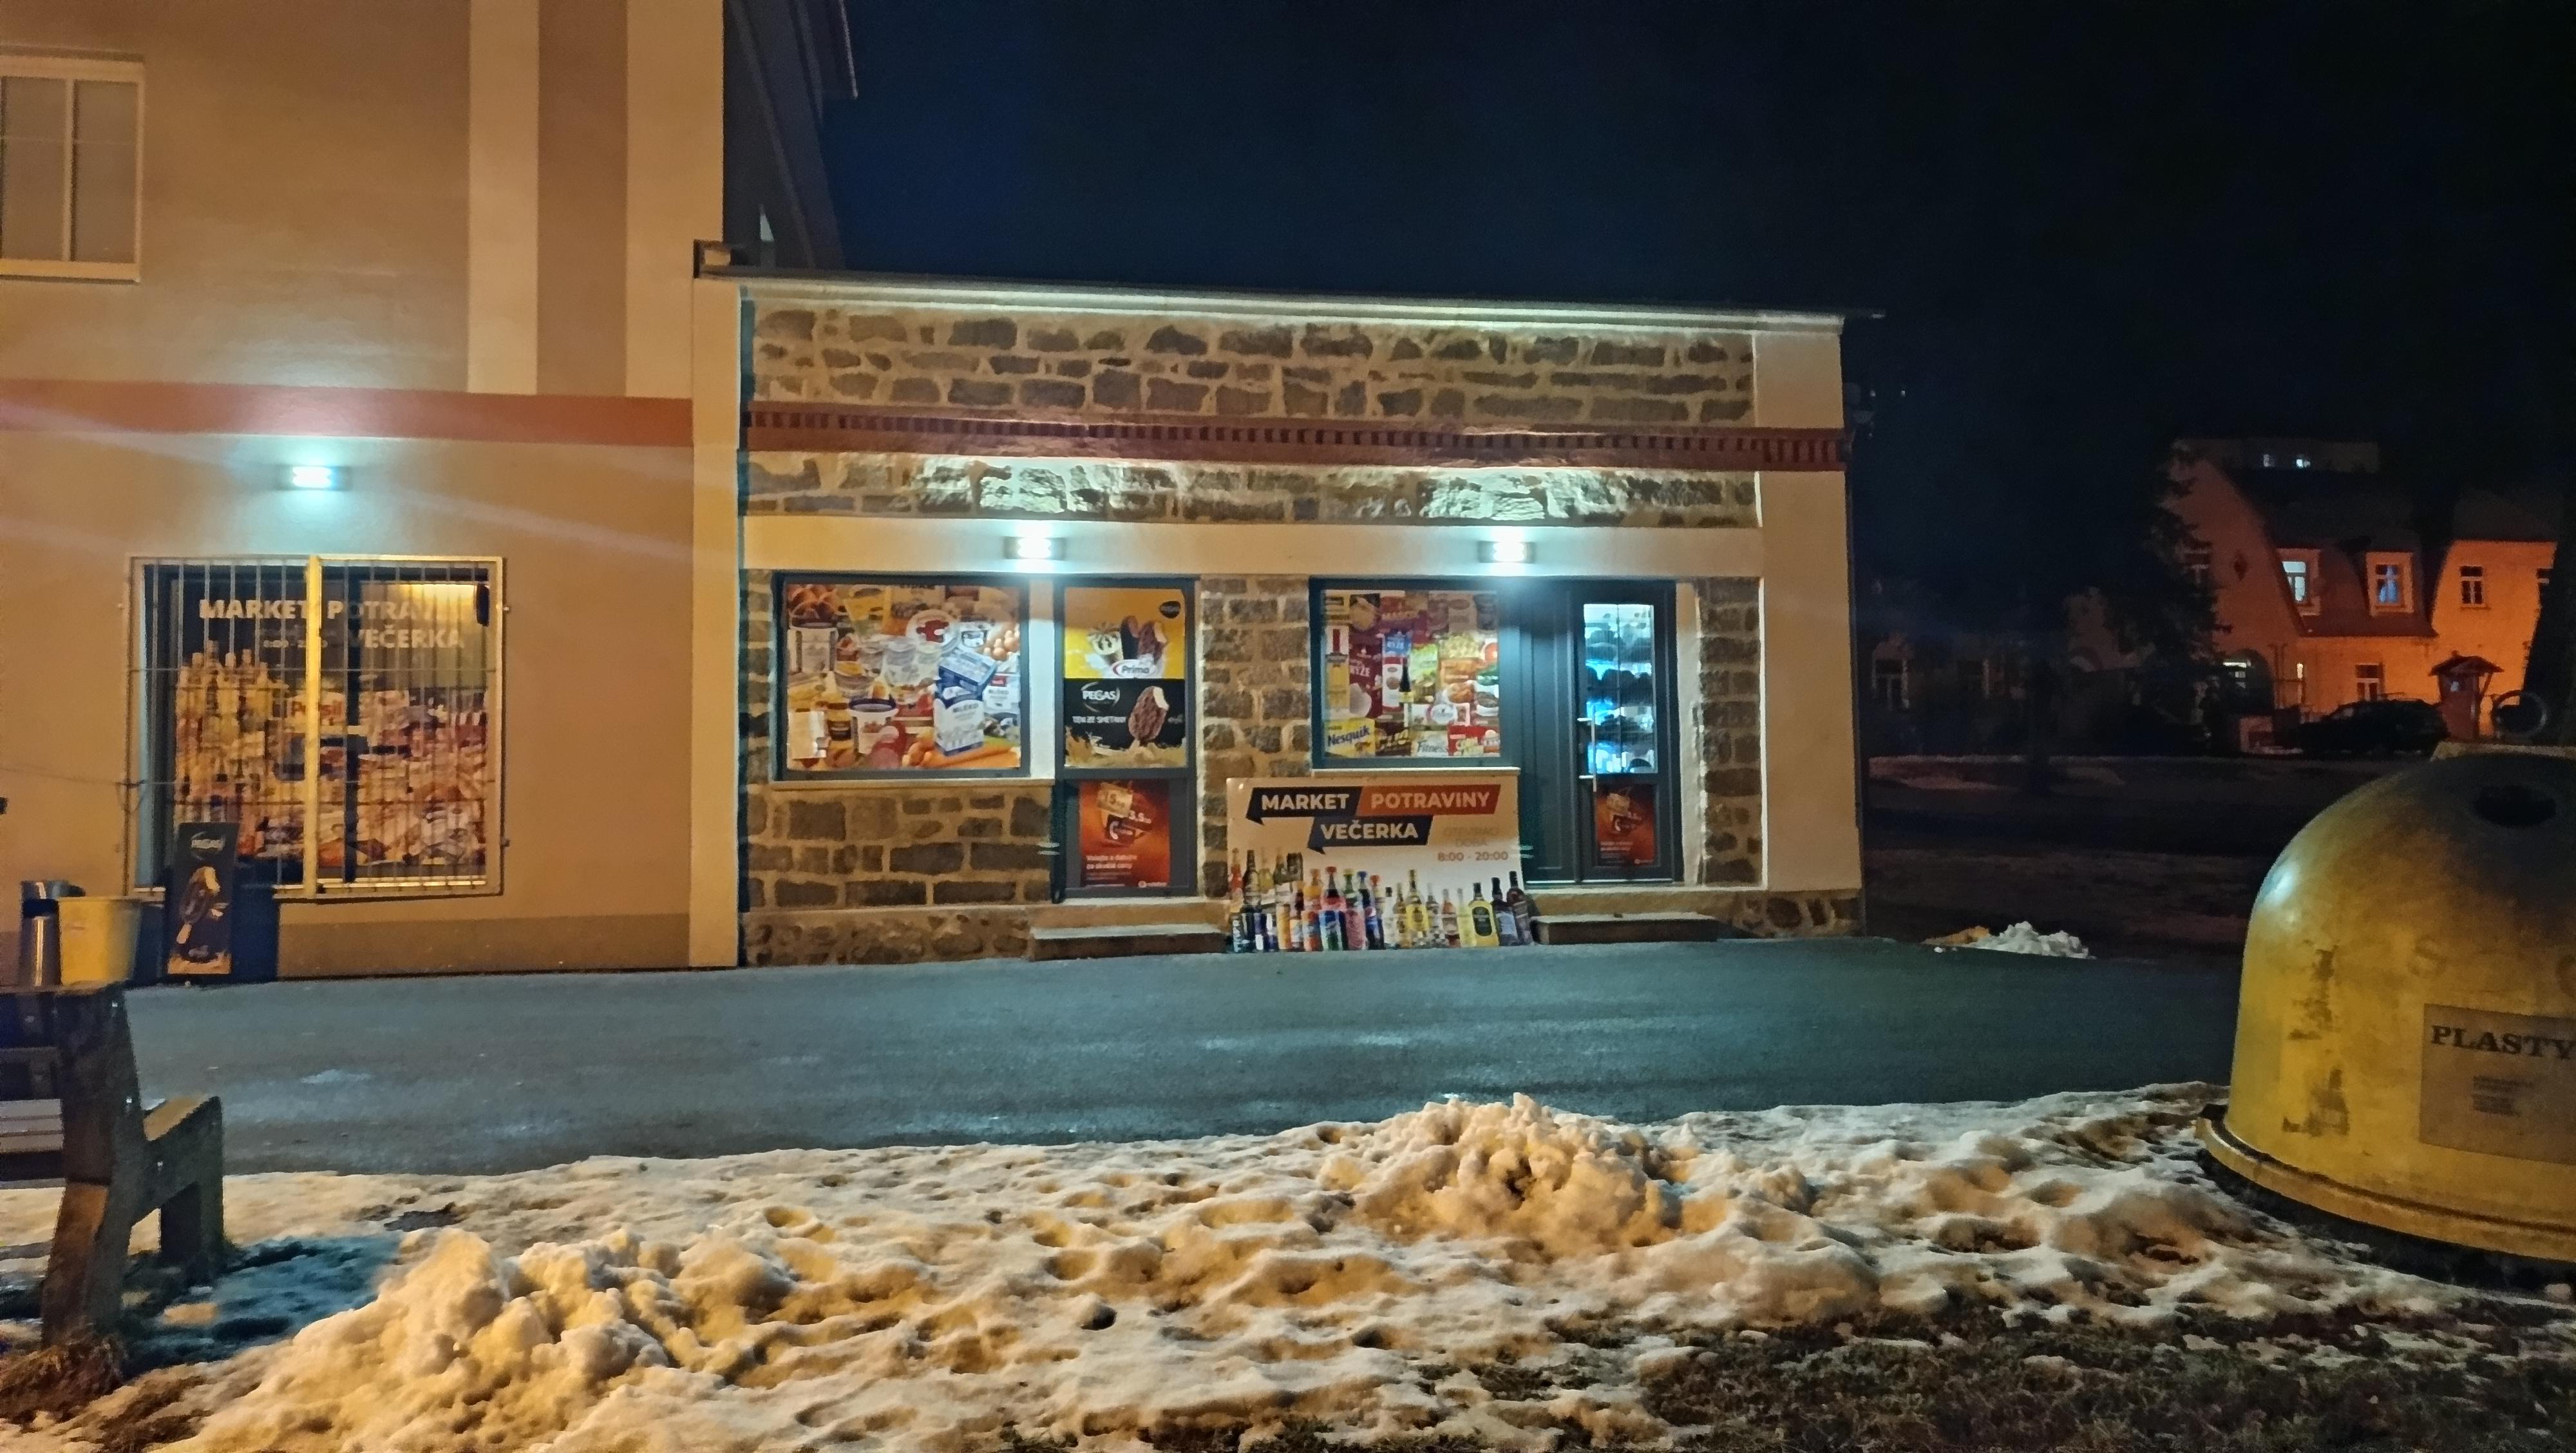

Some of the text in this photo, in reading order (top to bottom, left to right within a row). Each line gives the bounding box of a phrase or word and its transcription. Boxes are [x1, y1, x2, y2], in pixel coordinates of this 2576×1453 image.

[199, 599, 309, 619] MARKET
[1082, 690, 1116, 701] PEGAS
[1327, 725, 1370, 747] Nesquik
[1262, 792, 1491, 810] MARKET POTRAVINY
[1320, 820, 1419, 840] VEČERKA
[1437, 852, 1464, 862] 8:00
[1475, 851, 1509, 861] 20:00
[2431, 1025, 2576, 1060] PLASTY
